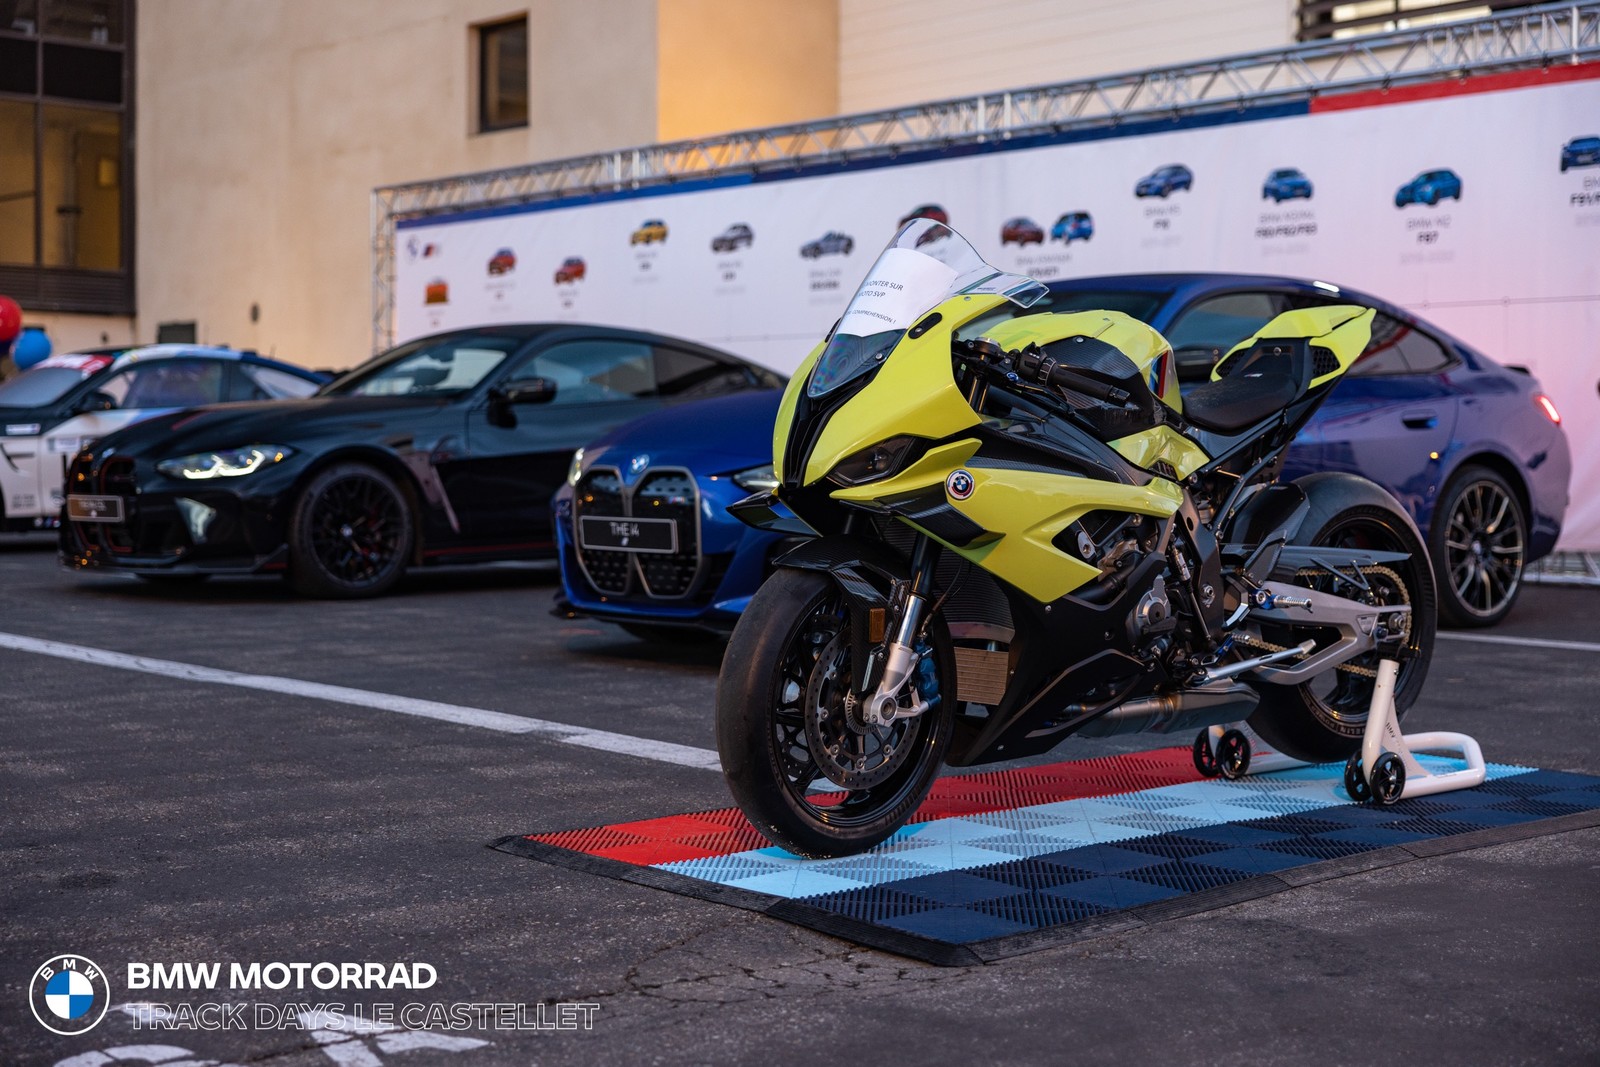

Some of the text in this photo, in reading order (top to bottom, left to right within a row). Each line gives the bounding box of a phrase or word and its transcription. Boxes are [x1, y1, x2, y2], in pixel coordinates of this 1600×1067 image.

[889, 282, 904, 291] SUR
[872, 290, 886, 298] SVP
[610, 521, 630, 536] THE
